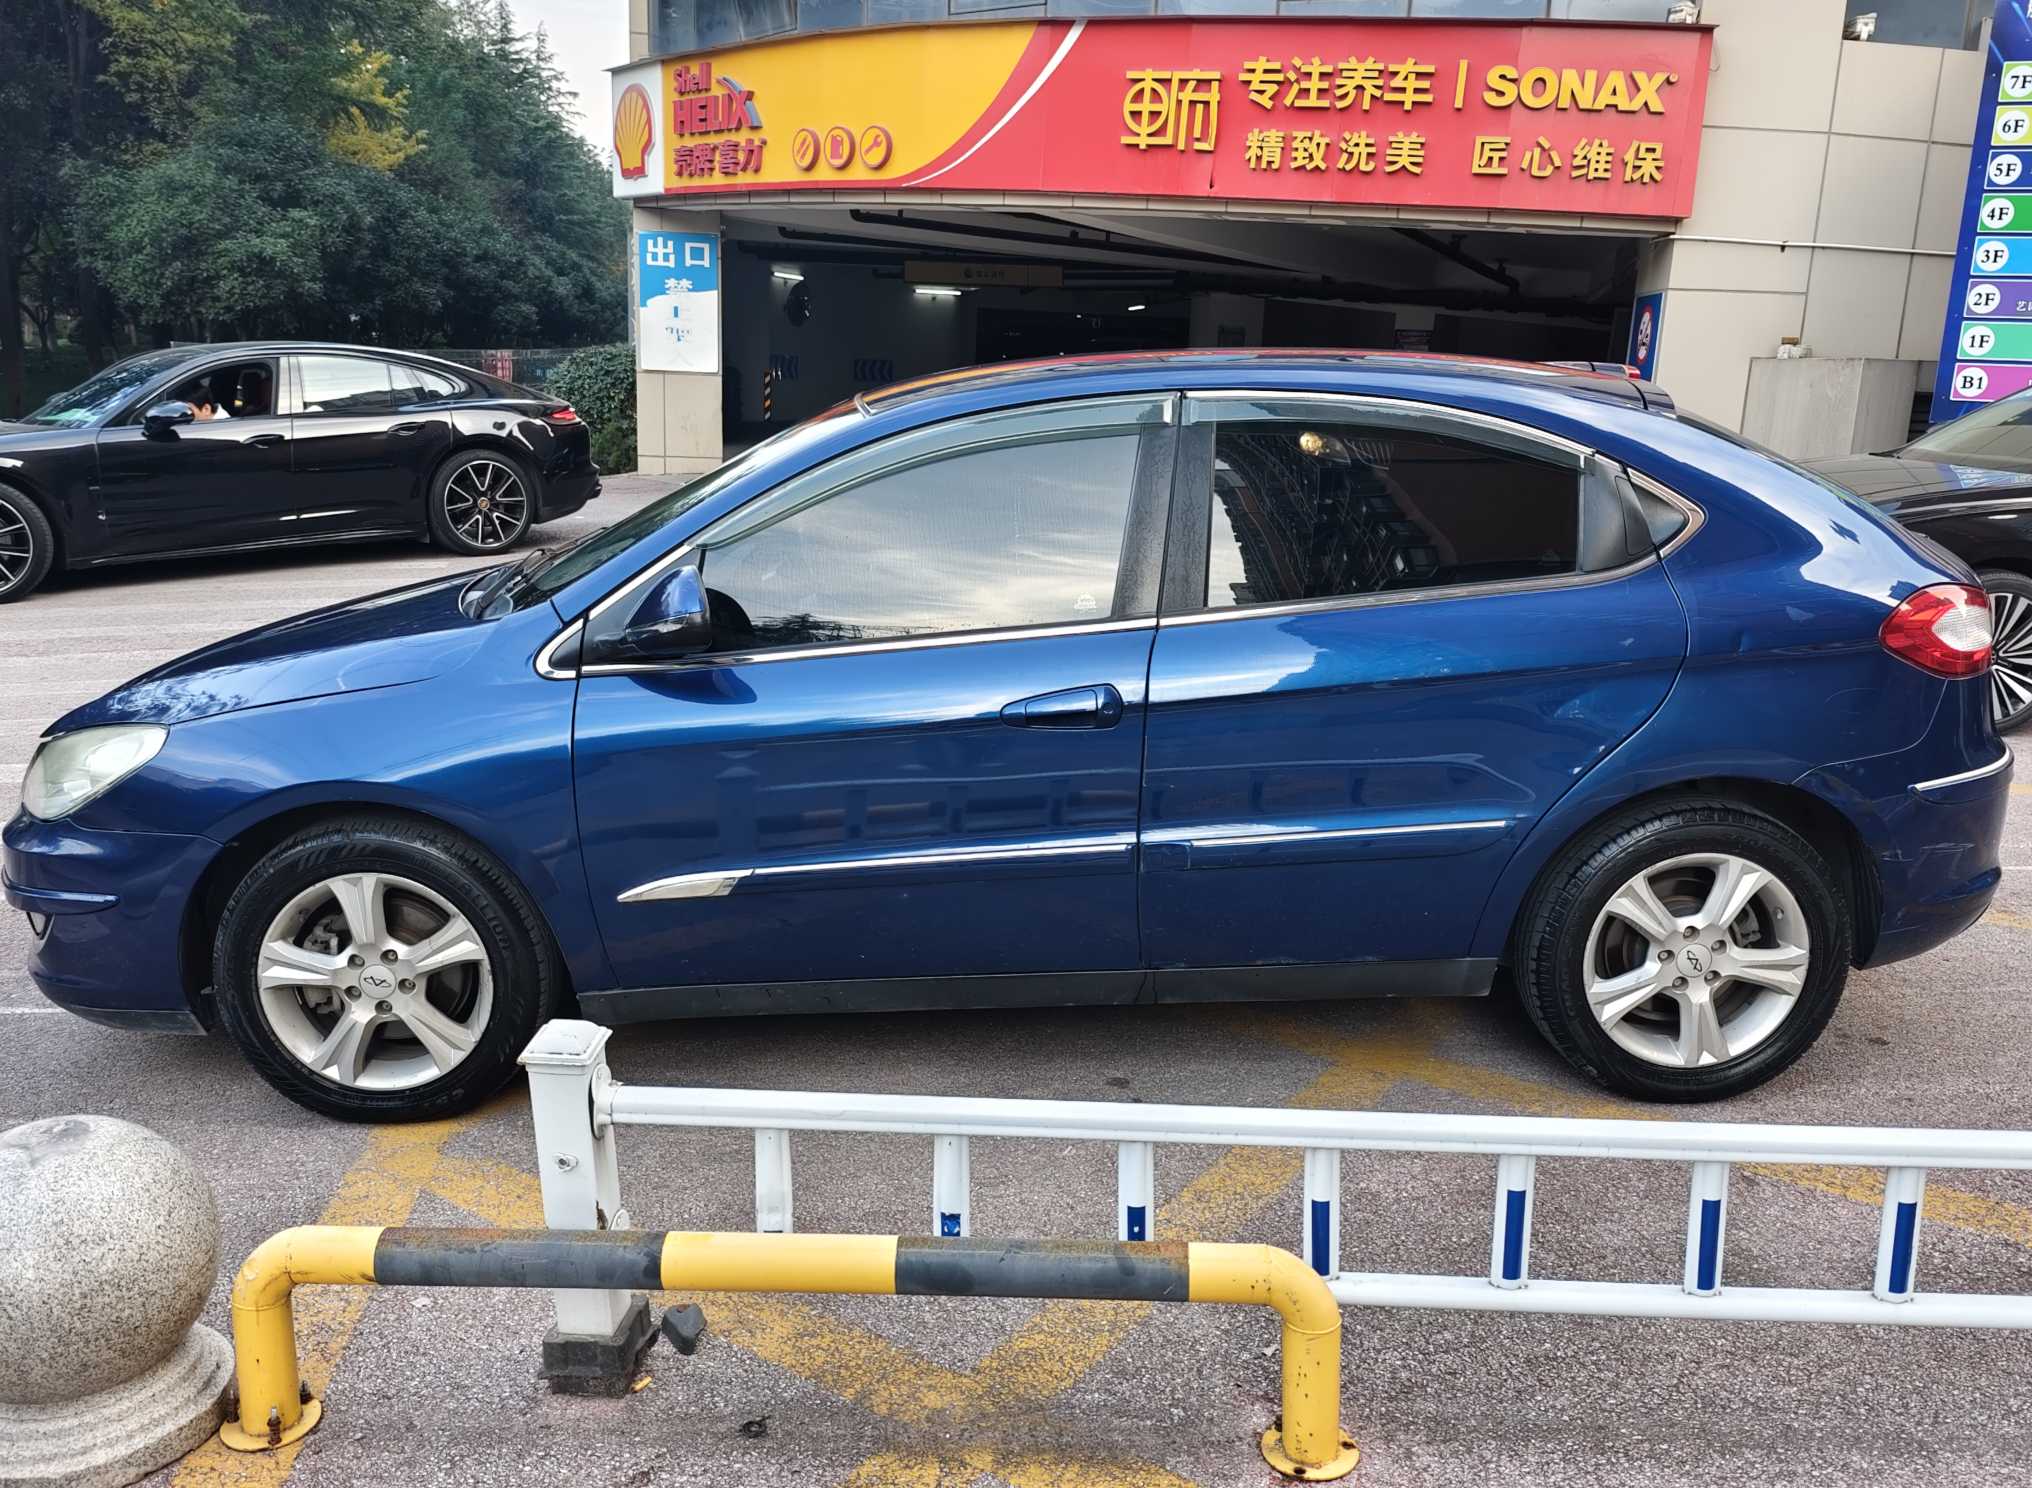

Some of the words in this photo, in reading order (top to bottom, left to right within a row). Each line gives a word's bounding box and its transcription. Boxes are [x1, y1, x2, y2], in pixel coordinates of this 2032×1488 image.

[674, 62, 712, 95] Shell
[1238, 56, 1436, 111] 专注养车
[1482, 65, 1670, 114] SONAX
[2010, 74, 2032, 90] 7F
[672, 90, 762, 137] HELIX
[2002, 119, 2025, 134] 6F
[673, 138, 767, 177] 壳牌喜力
[1244, 127, 1427, 175] 精致洗美
[1471, 135, 1665, 184] 匠心维保
[1993, 163, 2018, 177] 5F
[1987, 207, 2010, 221] 4F
[646, 236, 710, 268] 出口
[1981, 249, 2005, 264] 3F
[1973, 292, 1996, 306] 2F
[1969, 334, 1991, 348] 1F
[1960, 375, 1984, 390] B1
